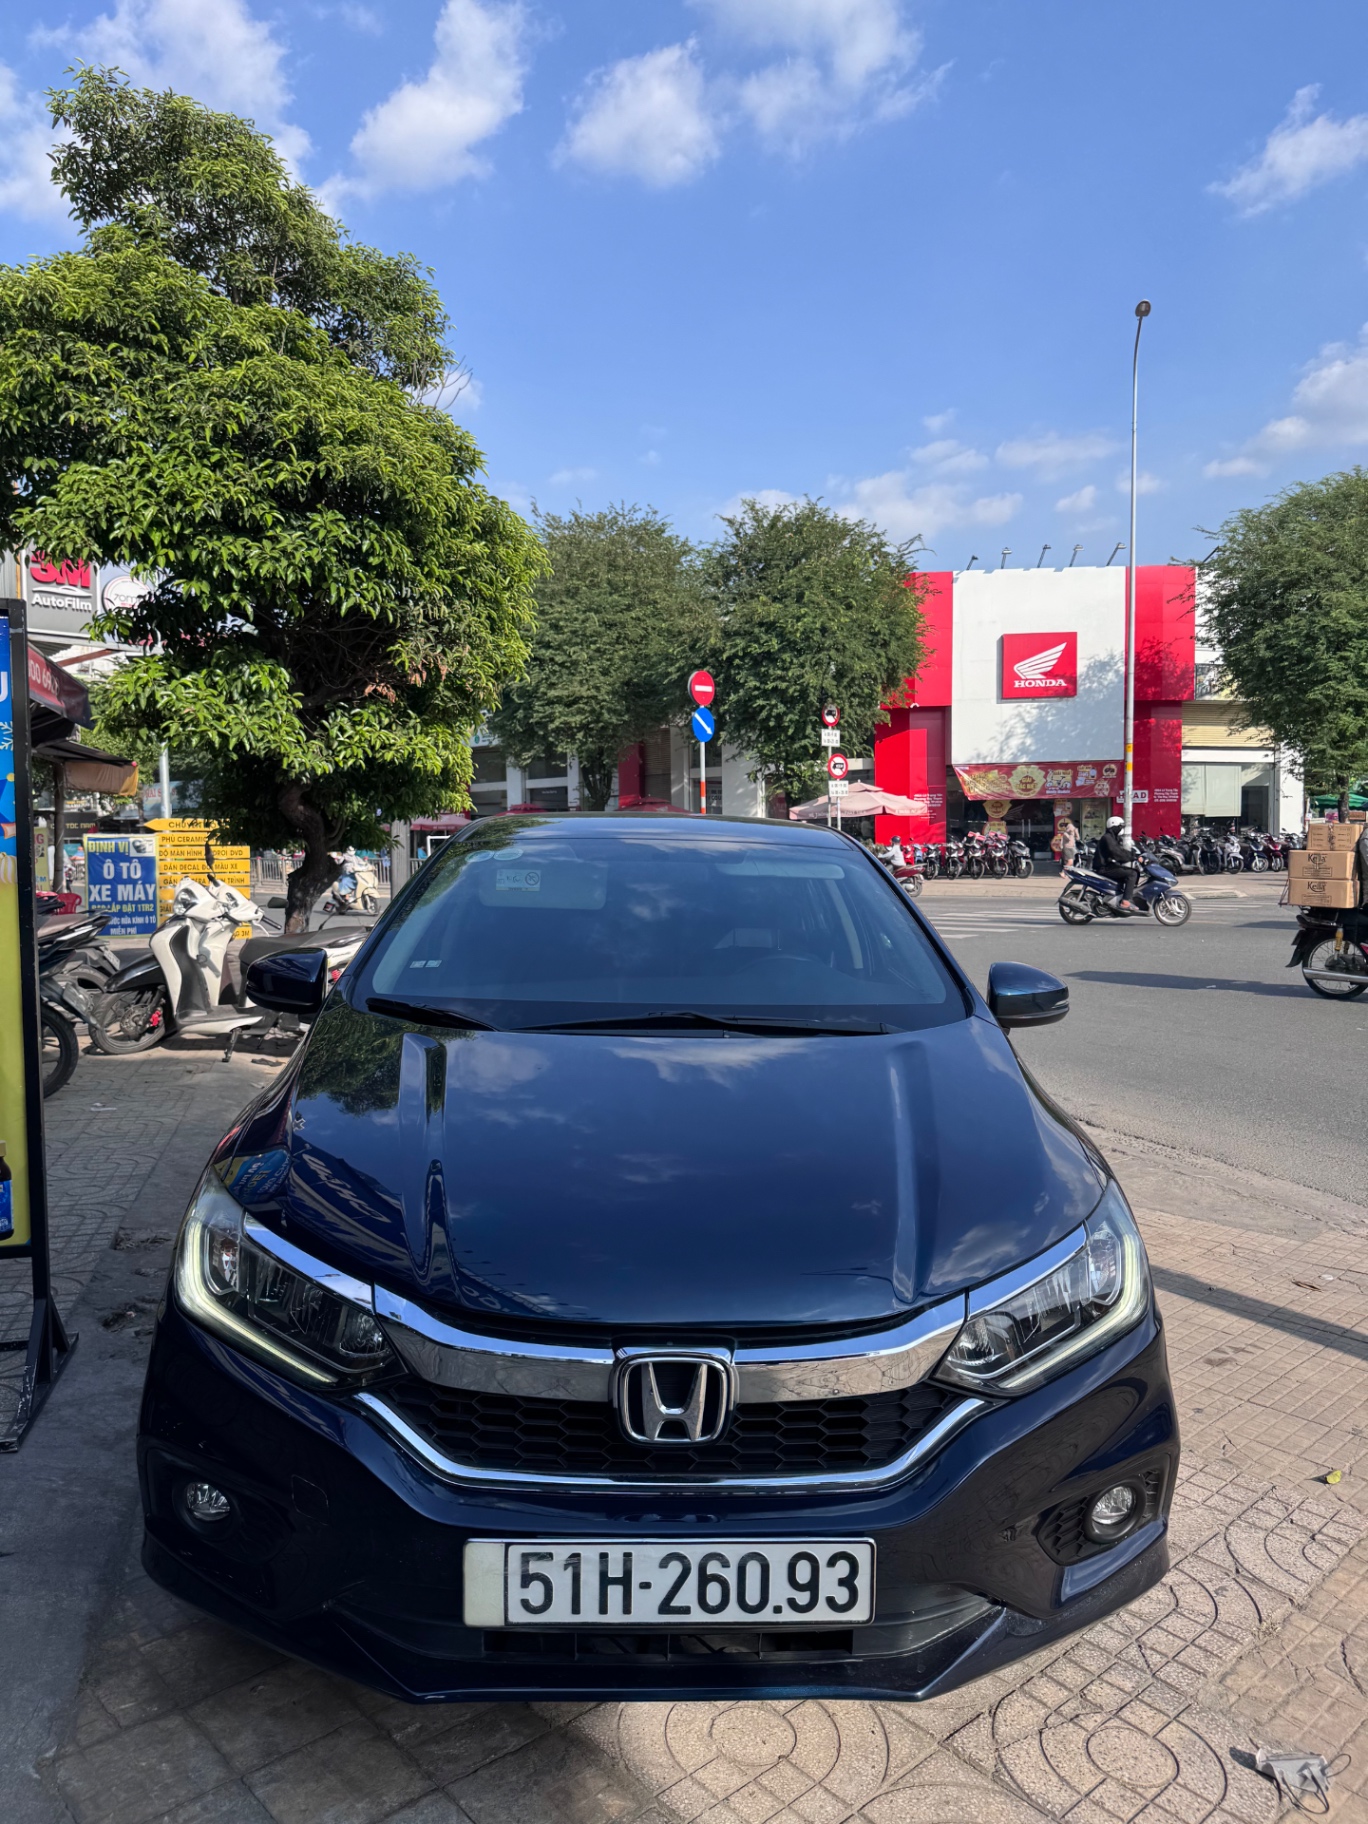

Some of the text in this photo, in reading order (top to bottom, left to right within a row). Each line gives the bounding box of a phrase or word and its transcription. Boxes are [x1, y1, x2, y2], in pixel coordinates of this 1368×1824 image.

[31, 593, 92, 611] AutoFilm
[1014, 679, 1067, 688] HONDA
[89, 841, 129, 856] ĐỊNH VỊ
[186, 848, 203, 856] HÌNH
[103, 858, 142, 880] Ô TÔ
[163, 862, 178, 871] DÁN
[227, 874, 245, 884] TRÌNH
[89, 881, 156, 902] XE MÁY
[519, 1550, 860, 1615] 51H-260.93
